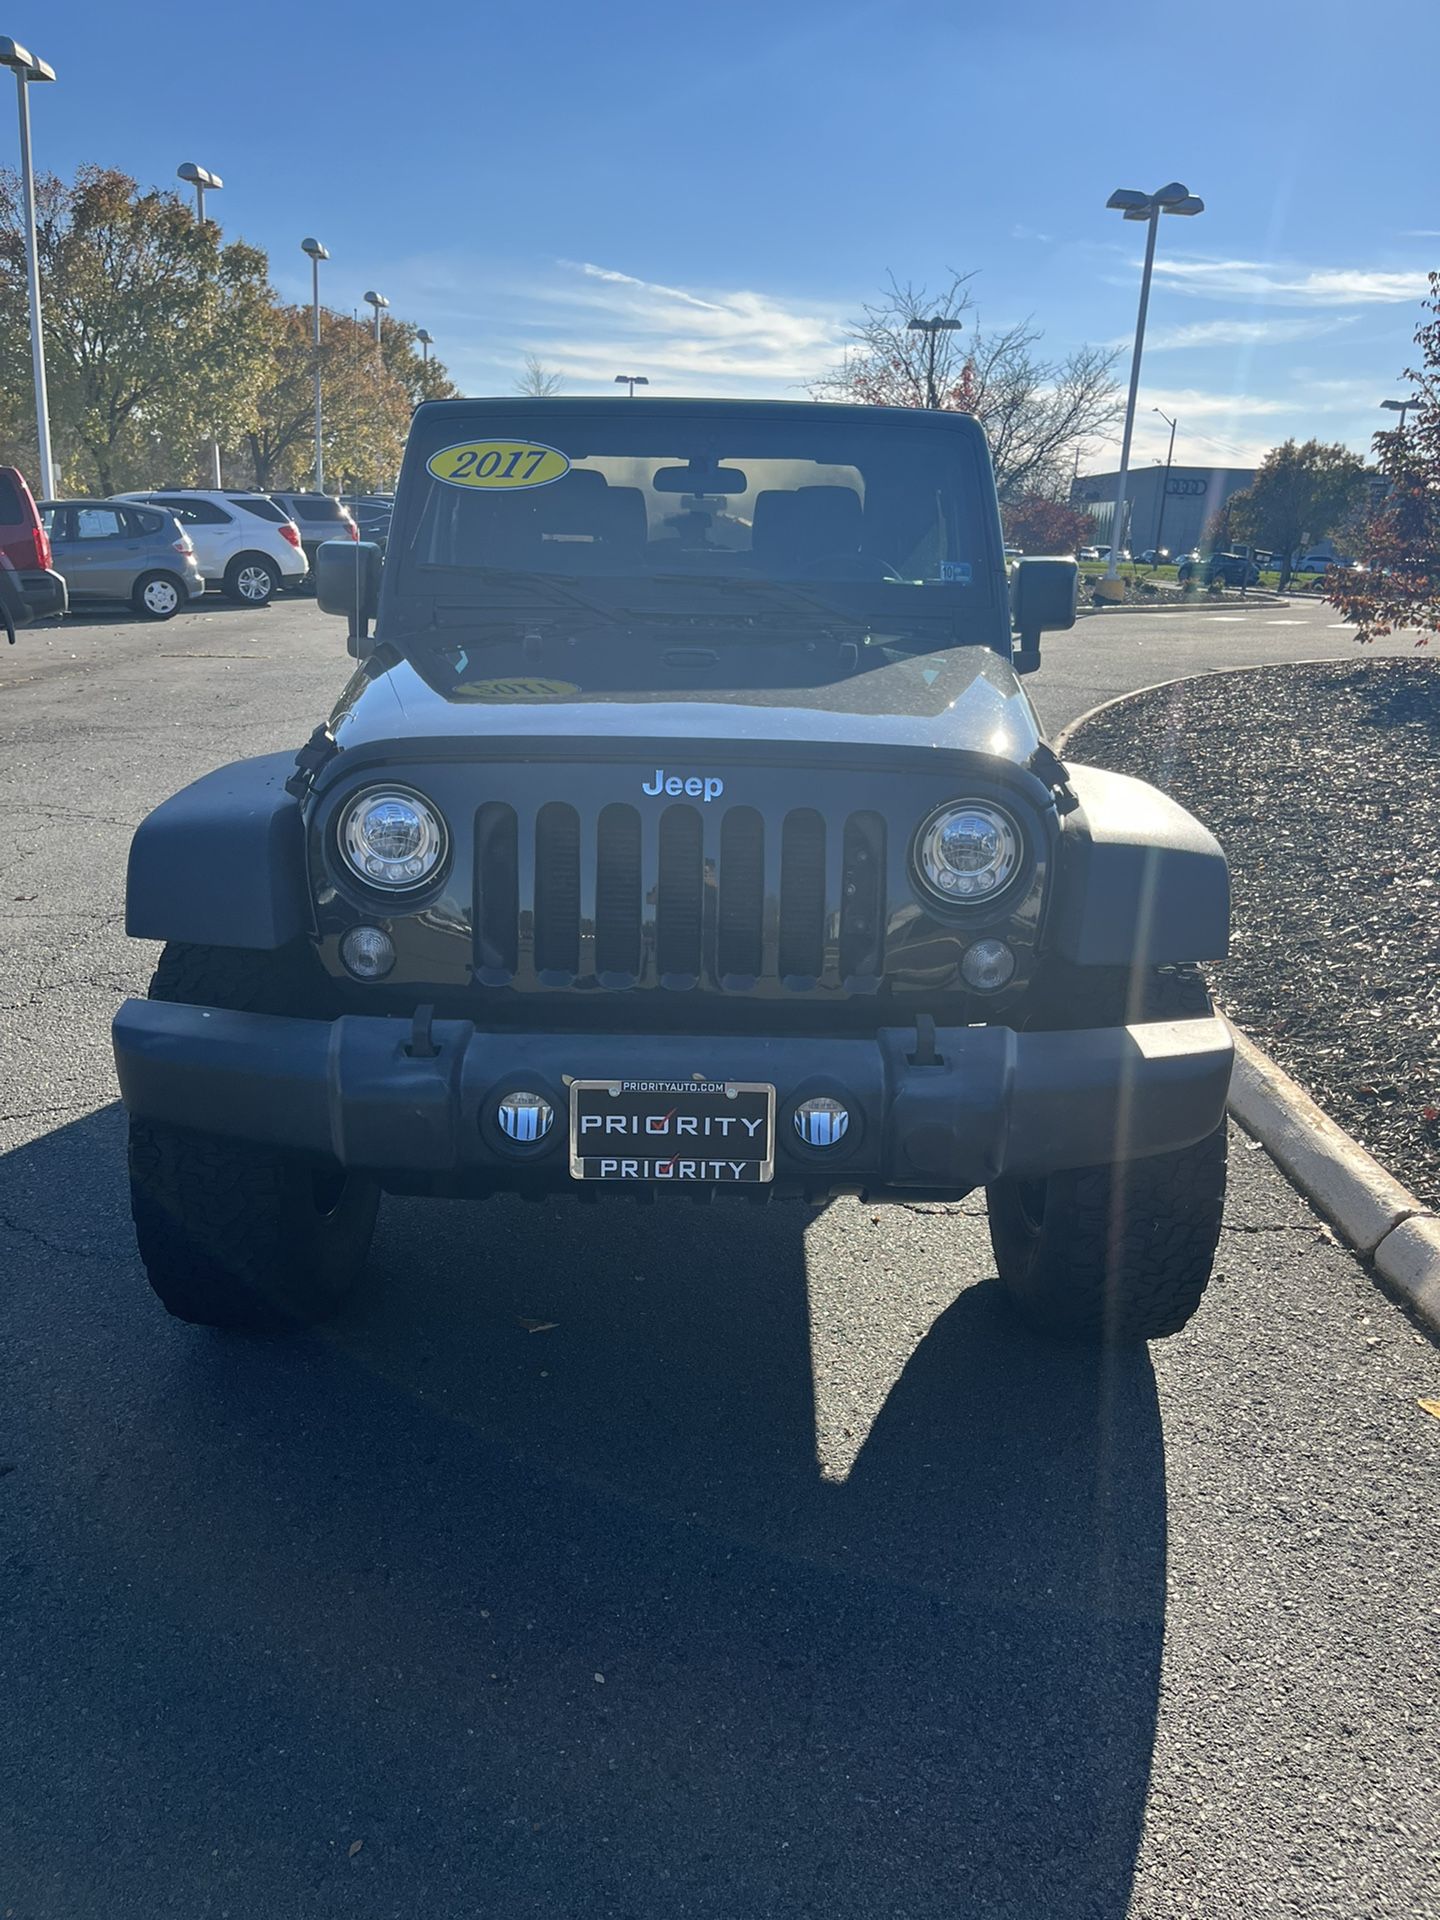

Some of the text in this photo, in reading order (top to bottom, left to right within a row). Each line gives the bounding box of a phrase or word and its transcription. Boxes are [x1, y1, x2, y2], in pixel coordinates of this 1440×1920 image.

[449, 451, 547, 480] 2017
[642, 769, 724, 802] Jeep
[623, 1081, 724, 1093] PRIORITYAUTO.COM
[581, 1115, 764, 1137] PRIORITY
[600, 1160, 747, 1180] PRIORITY
